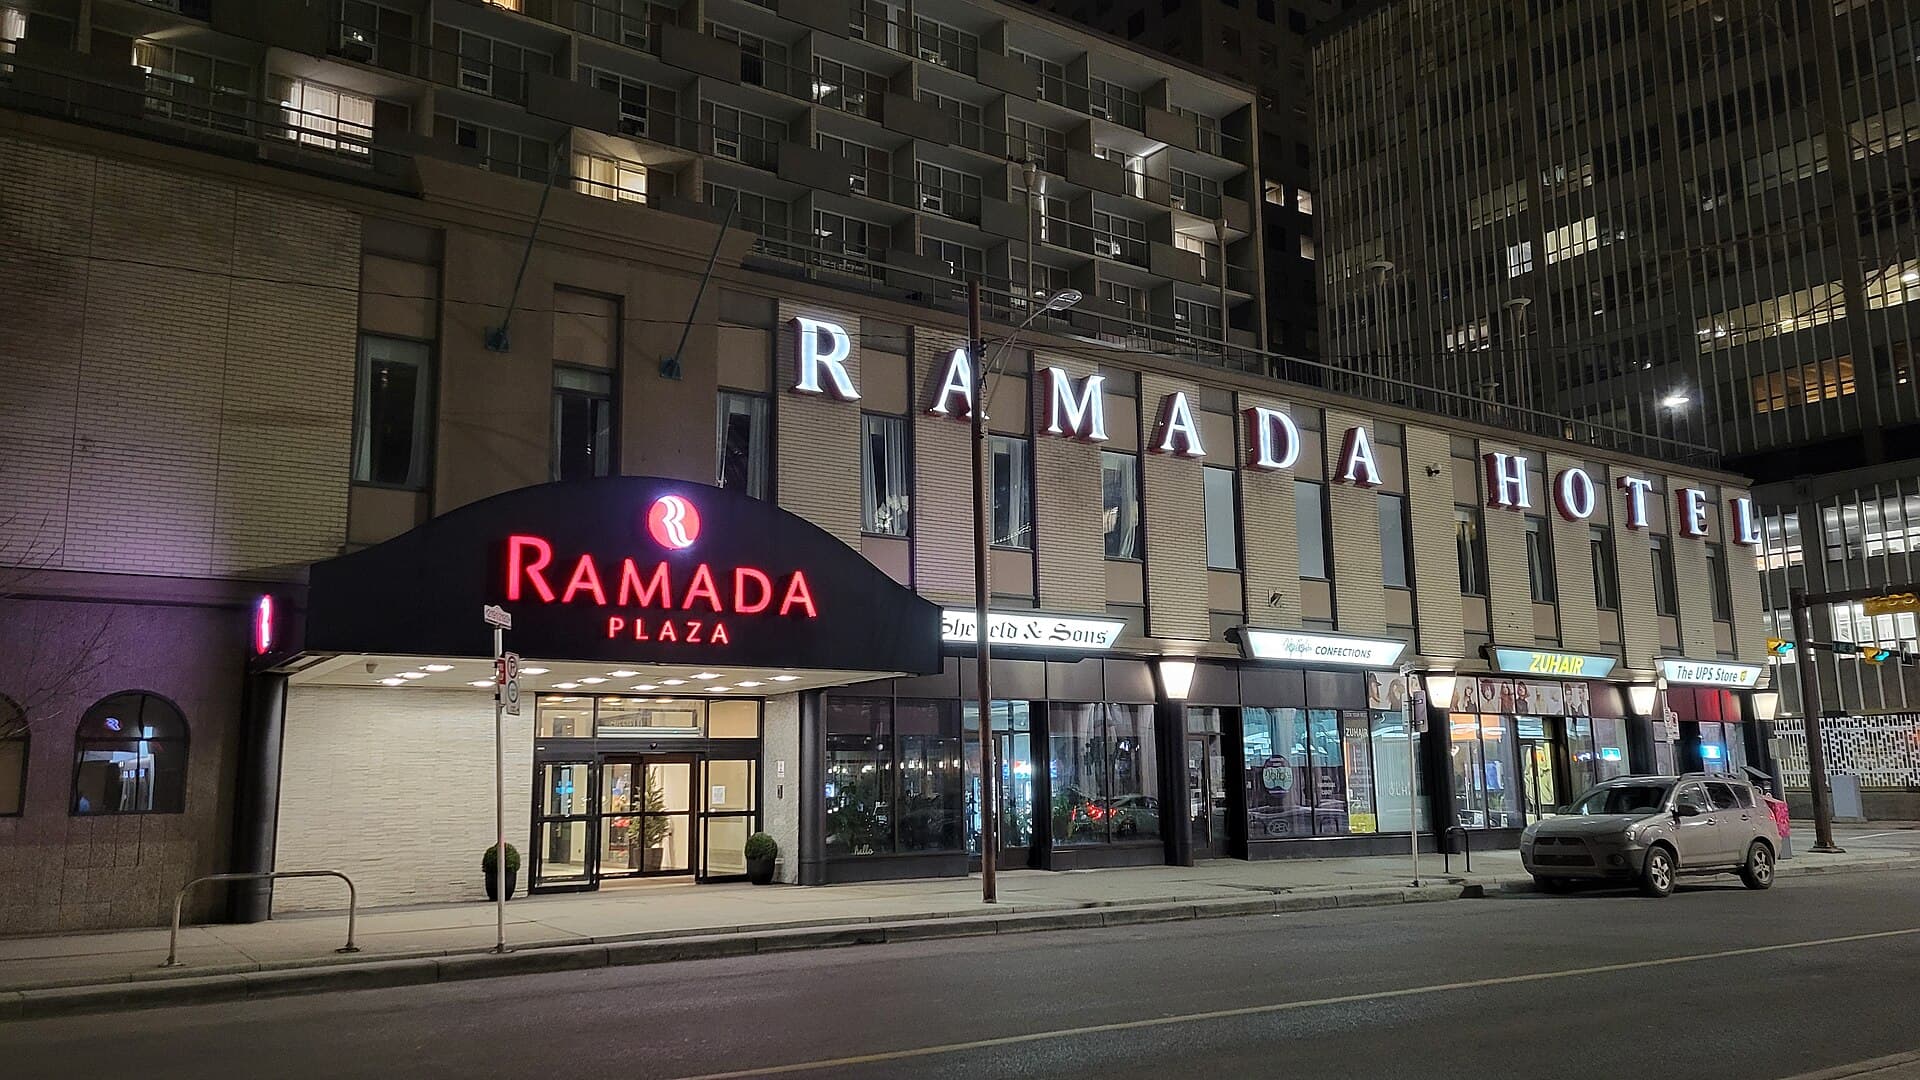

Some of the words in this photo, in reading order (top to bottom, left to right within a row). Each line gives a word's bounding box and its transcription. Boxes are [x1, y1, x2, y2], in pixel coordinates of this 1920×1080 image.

[793, 316, 1383, 488] RAMADA
[1484, 451, 1763, 546] HOTEL
[506, 534, 818, 618] RAMADA
[608, 616, 729, 644] PLAZA
[942, 617, 1018, 639] Sheeld
[1023, 621, 1043, 640] &
[1048, 623, 1108, 645] Sons
[1315, 645, 1372, 659] CONFECTIONS
[1529, 653, 1585, 675] ZUHAIR
[1677, 665, 1693, 679] The
[1695, 666, 1713, 681] UPS
[1715, 668, 1738, 682] Store
[854, 844, 874, 856] hello
